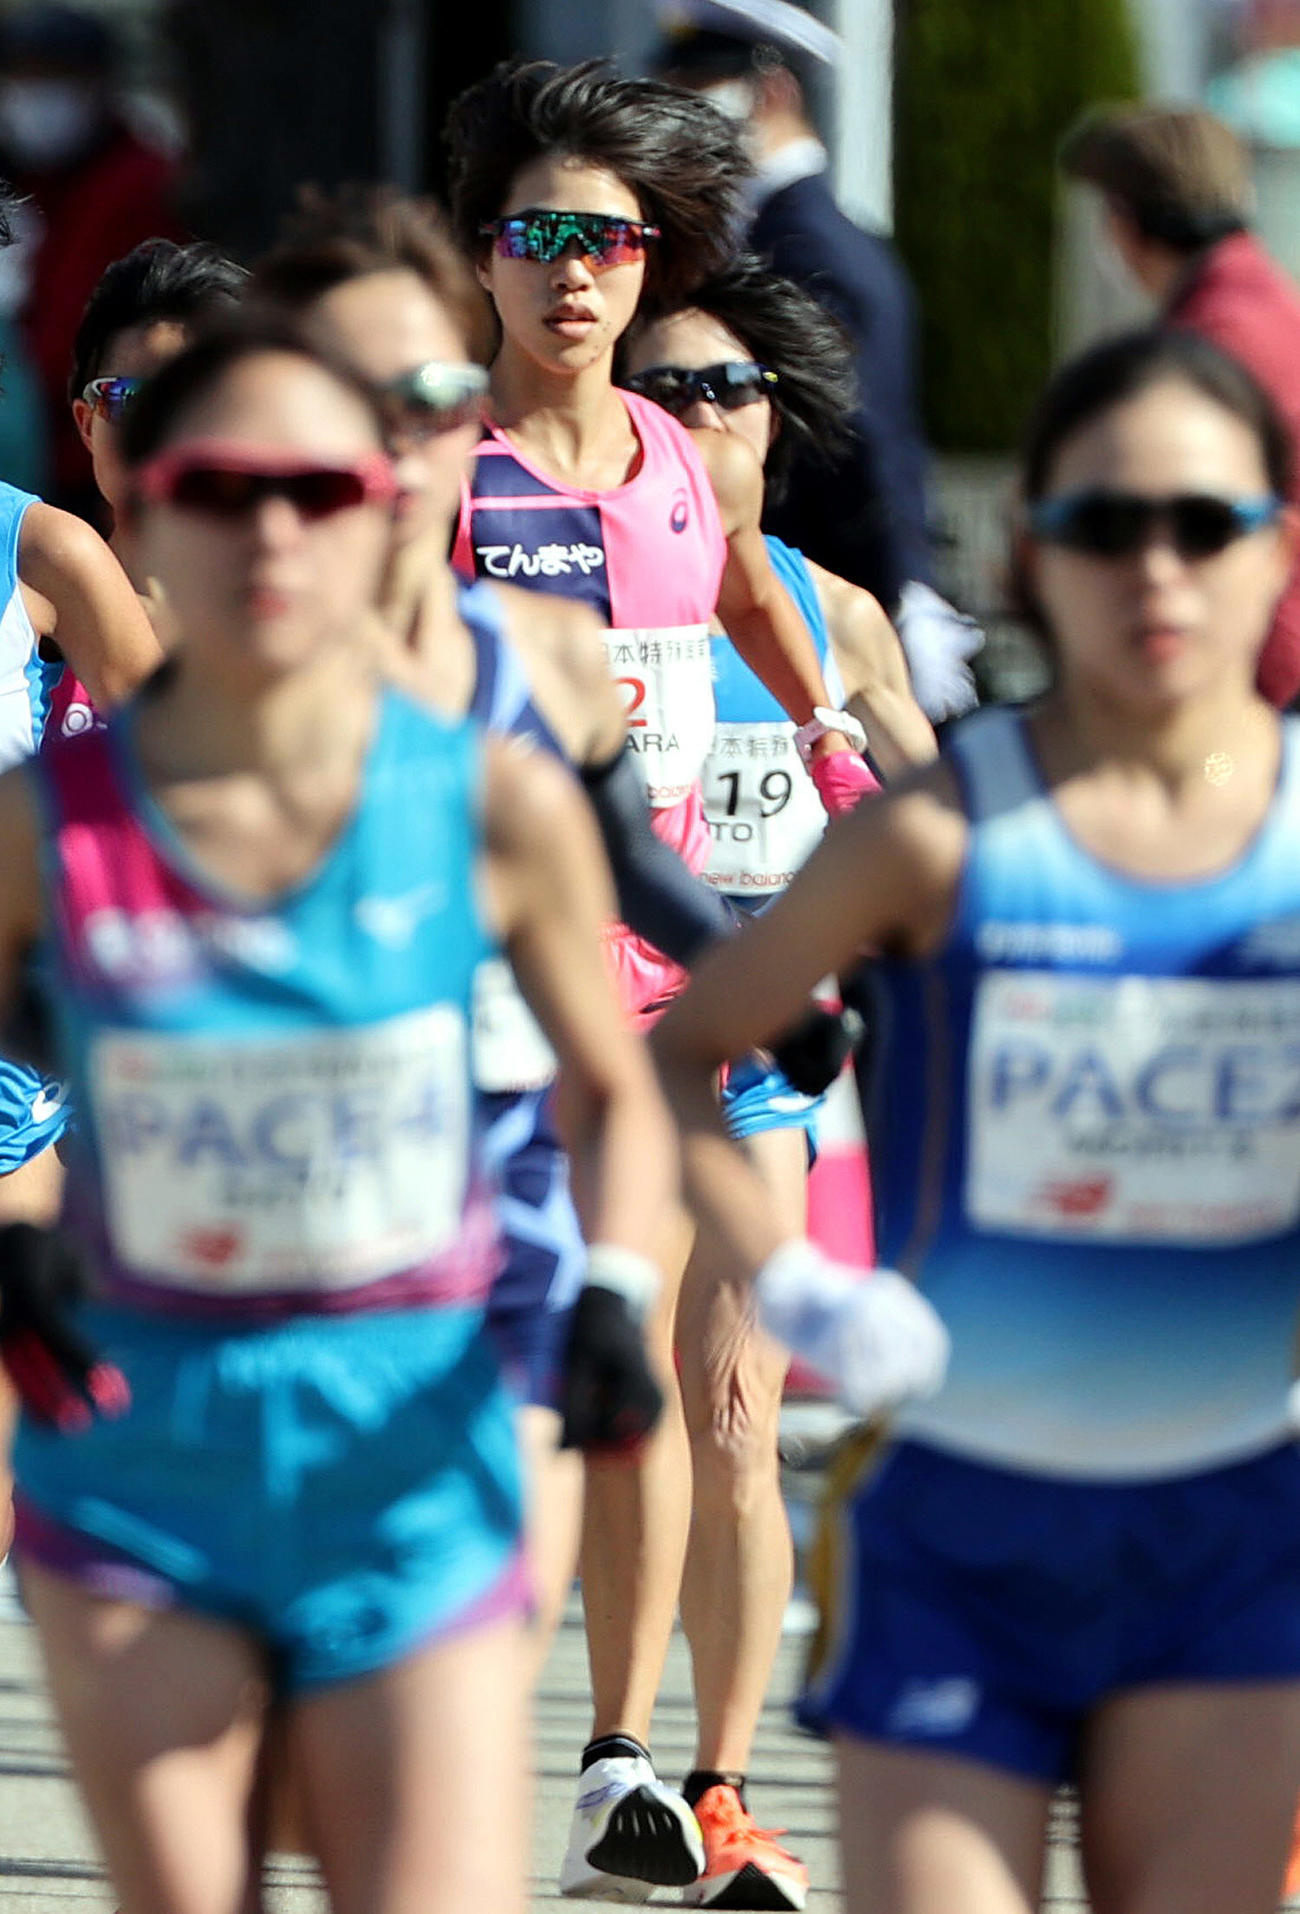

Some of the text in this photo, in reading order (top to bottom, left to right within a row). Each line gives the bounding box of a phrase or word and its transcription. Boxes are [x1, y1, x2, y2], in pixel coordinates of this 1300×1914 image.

[476, 543, 605, 577] てんまや
[627, 733, 681, 752] ARA
[718, 769, 793, 818] 19
[707, 822, 753, 842] TO
